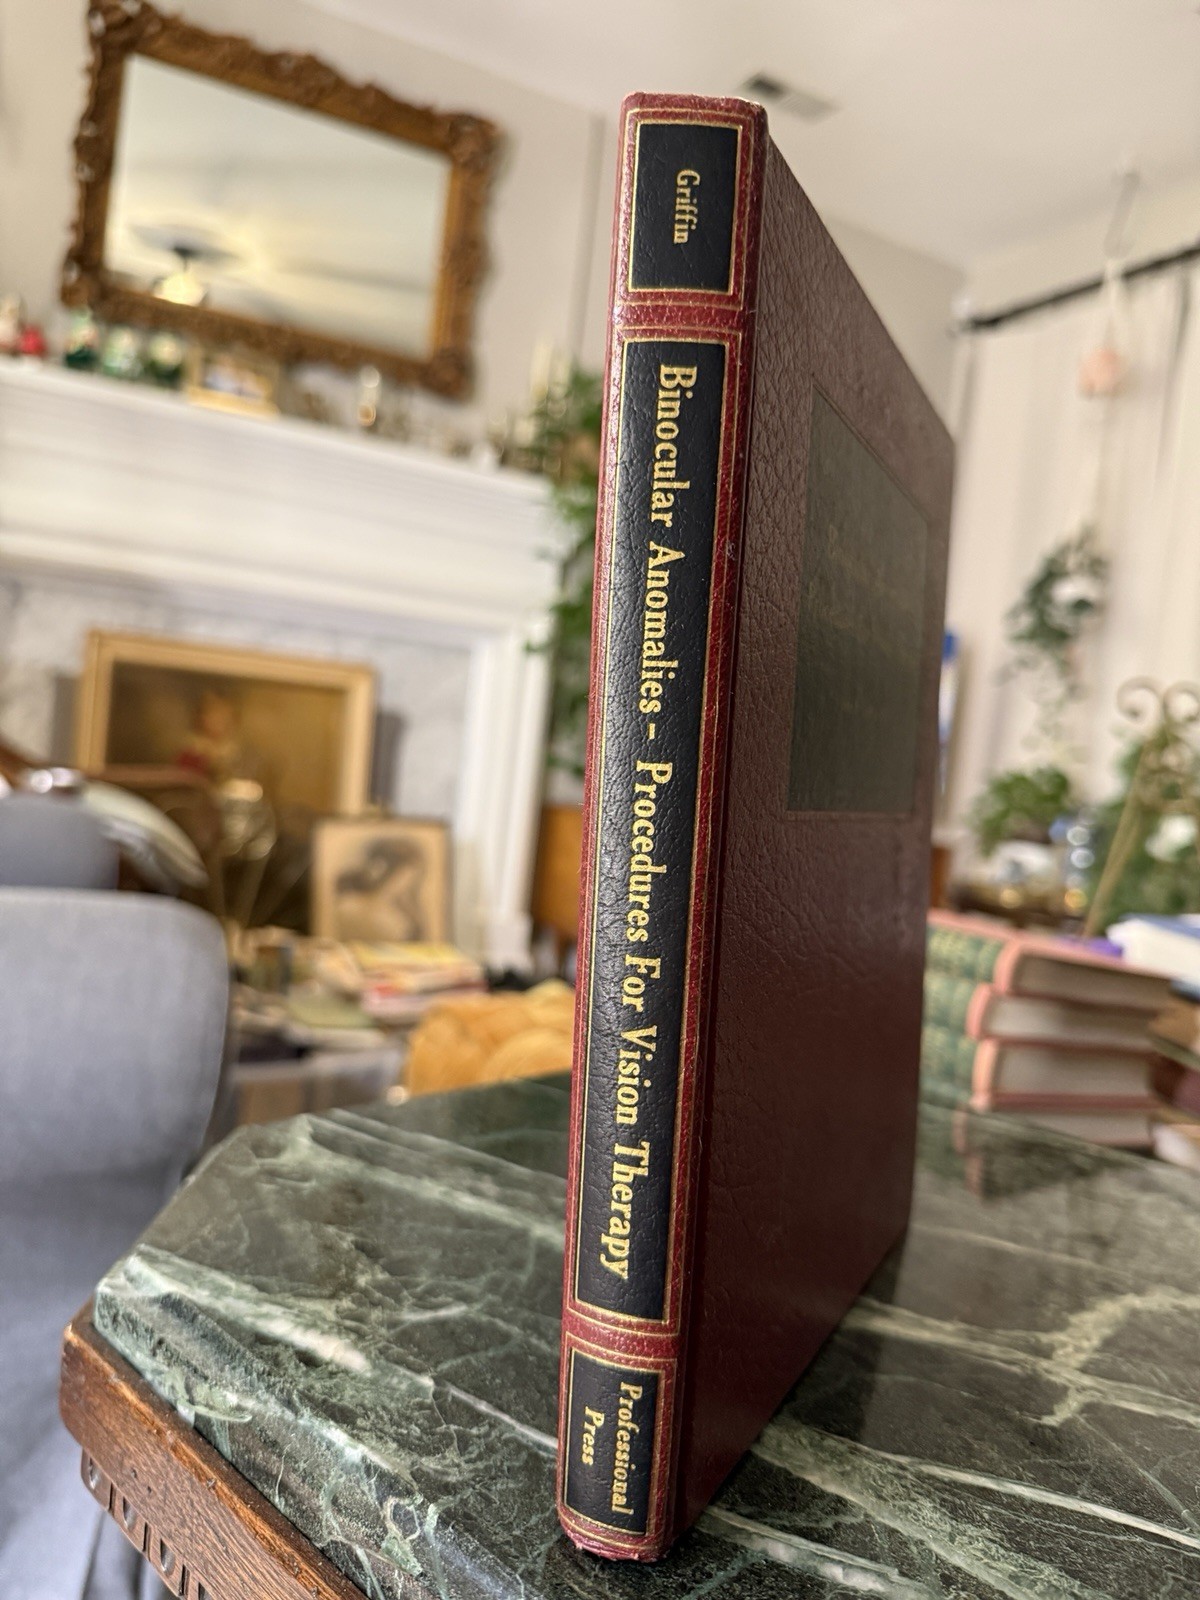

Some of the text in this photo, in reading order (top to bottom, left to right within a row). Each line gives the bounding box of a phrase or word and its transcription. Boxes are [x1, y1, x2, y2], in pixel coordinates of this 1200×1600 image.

[674, 170, 701, 244] Griffin
[599, 363, 697, 1281] Binocular Anomalies - Procedures For Vision Therapy
[581, 1406, 605, 1467] Press
[611, 1382, 643, 1516] Professional
